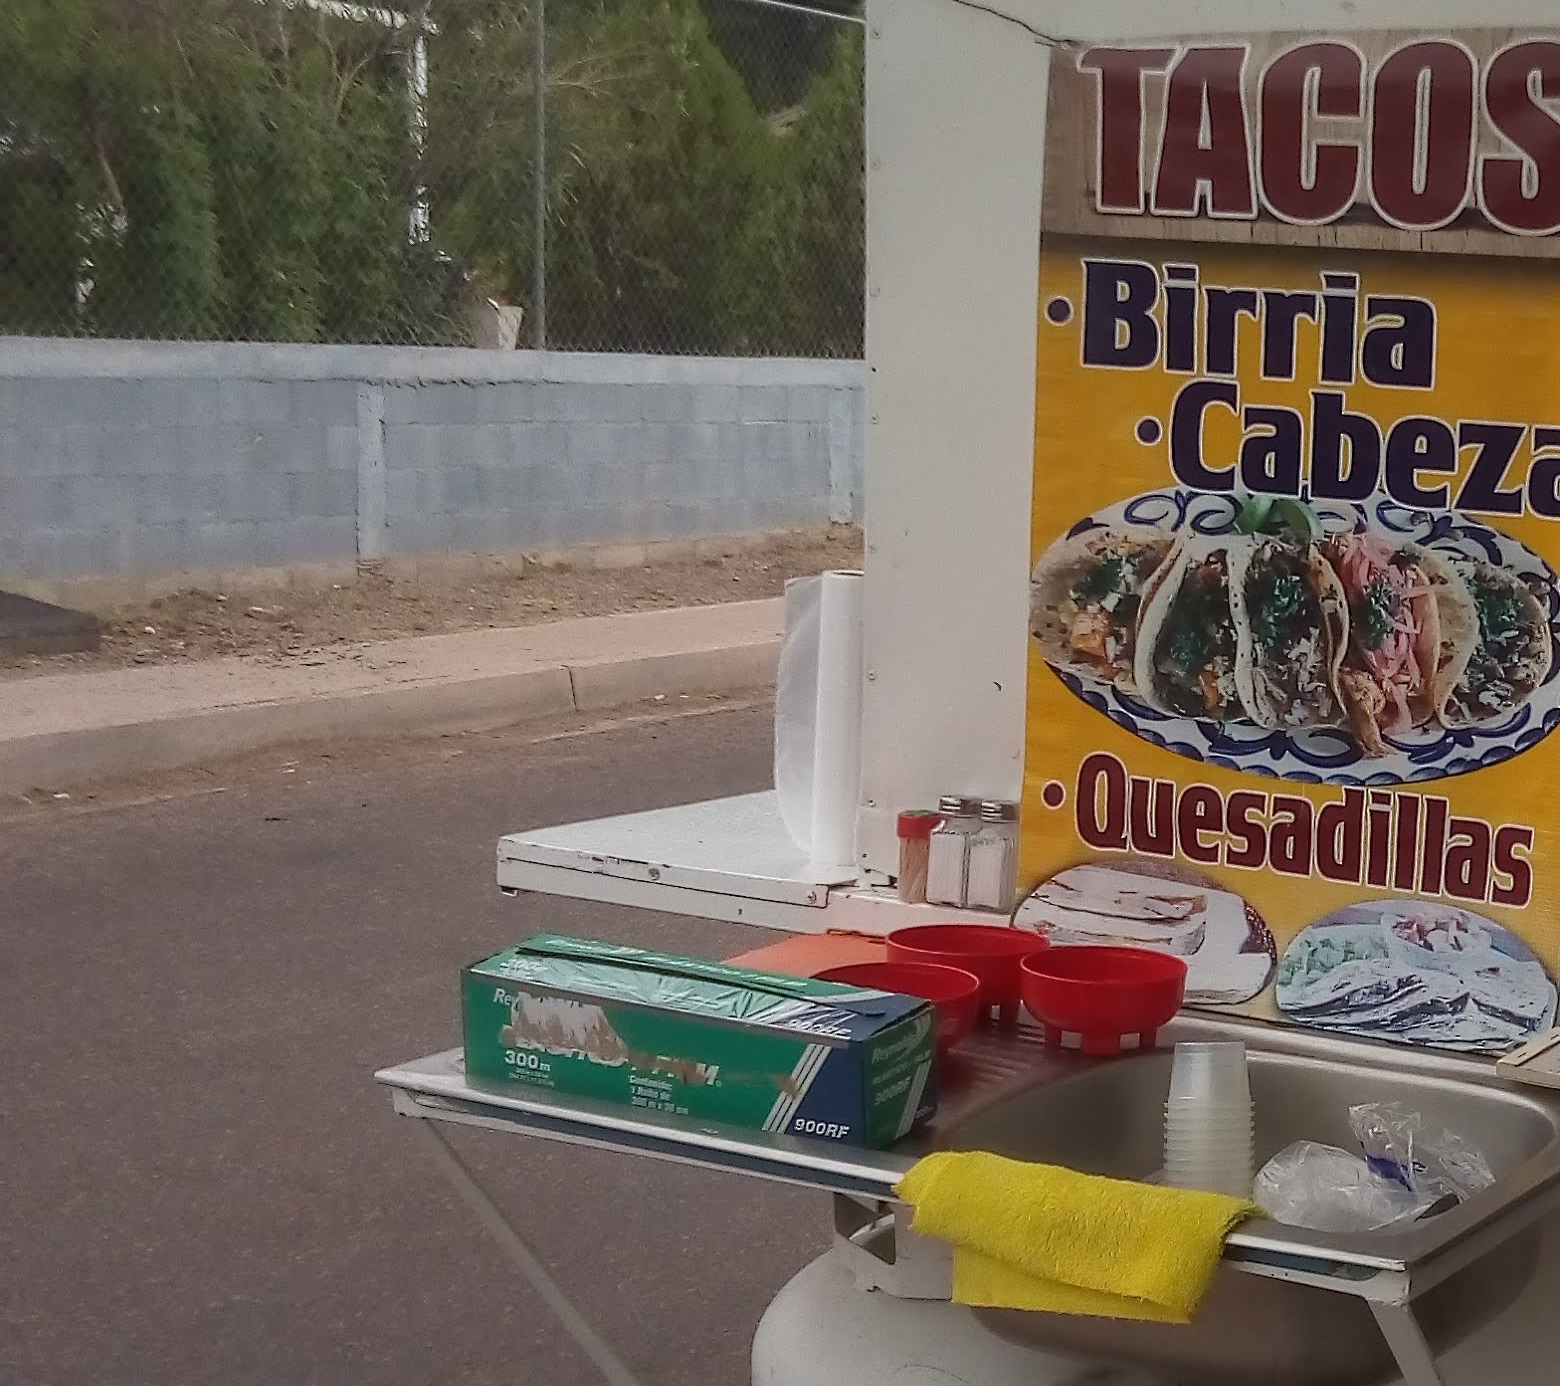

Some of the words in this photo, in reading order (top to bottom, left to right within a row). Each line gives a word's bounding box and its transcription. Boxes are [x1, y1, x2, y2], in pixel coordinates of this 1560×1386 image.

[1080, 257, 1437, 389] Birria
[1075, 750, 1536, 908] Quesadillas
[794, 1118, 850, 1139] 900RF
